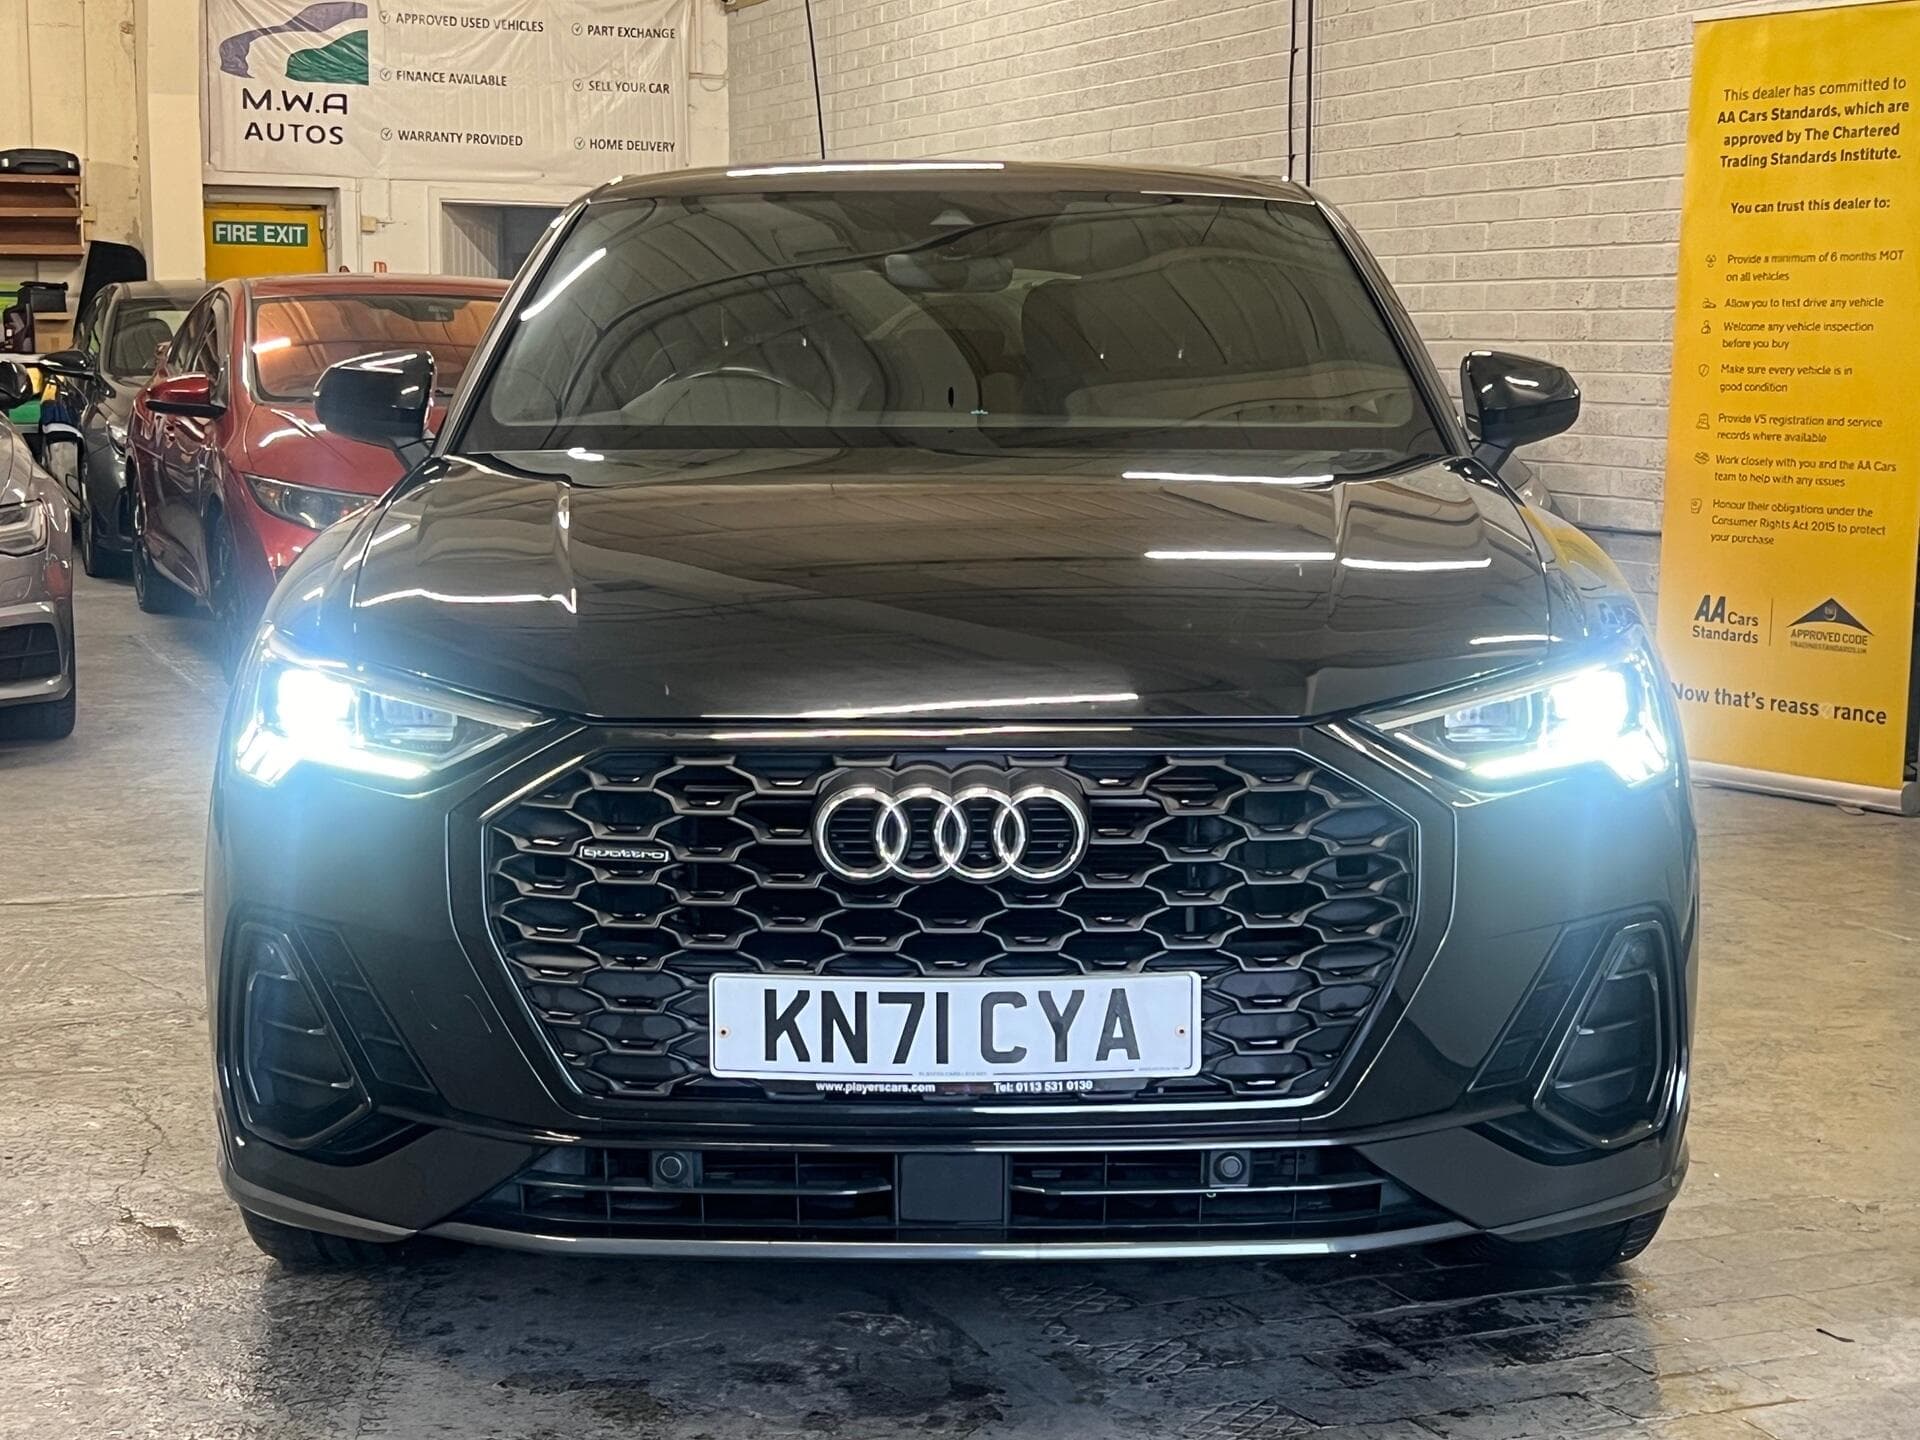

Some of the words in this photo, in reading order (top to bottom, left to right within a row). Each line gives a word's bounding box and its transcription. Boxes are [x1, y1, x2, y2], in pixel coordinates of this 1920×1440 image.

[396, 13, 457, 27] APPROVED
[461, 17, 490, 29] USED
[493, 19, 544, 32] VEHICLES
[587, 25, 614, 38] PART
[617, 26, 676, 39] EXCHANGE
[396, 70, 445, 84] FINANCE
[448, 73, 508, 87] AVAILABLE
[588, 80, 612, 92] SELL
[614, 81, 646, 94] YOUR
[648, 82, 670, 95] CAR
[1724, 88, 1748, 101] This
[1752, 85, 1791, 100] dealer
[1794, 84, 1815, 97] has
[1819, 77, 1889, 95] committed
[1893, 77, 1906, 89] to
[242, 88, 347, 115] M.W.A
[1717, 112, 1735, 125] AA
[1739, 110, 1768, 123] Cars
[1771, 105, 1841, 121] Standards,
[1844, 101, 1885, 116] which
[1887, 101, 1909, 113] are
[244, 122, 344, 145] AUTOS
[398, 129, 463, 144] WARRANTY
[466, 133, 523, 146] PROVIDED
[1723, 130, 1783, 147] approved
[1786, 129, 1802, 144] by
[1804, 128, 1829, 141] The
[1833, 123, 1900, 139] Chartered
[589, 138, 623, 151] HOME
[626, 139, 675, 152] DELIVERY
[1720, 155, 1768, 169] Trading
[1770, 150, 1837, 166] Standards
[1840, 147, 1901, 161] Institute.
[1731, 202, 1752, 214] You
[1754, 203, 1774, 213] can
[1777, 201, 1804, 212] trust
[1808, 199, 1830, 211] this
[1833, 198, 1871, 210] dealer
[1873, 197, 1890, 208] to:
[216, 224, 257, 242] FIRE
[263, 225, 305, 244] EXIT
[1727, 254, 1761, 264] Provide
[1771, 254, 1815, 263] minimum
[1818, 252, 1829, 262] of
[1830, 252, 1838, 262] 6
[1839, 252, 1876, 262] months
[1879, 250, 1904, 260] MOT
[1726, 273, 1738, 282] on
[1740, 272, 1750, 281] all
[1752, 272, 1790, 281] vehicles
[1724, 298, 1750, 308] Allow
[1751, 300, 1768, 309] you
[1770, 299, 1779, 308] to
[1803, 298, 1827, 307] drive
[1829, 299, 1846, 309] any
[1849, 297, 1884, 307] vehicle
[1723, 322, 1765, 331] Welcome
[1767, 323, 1783, 333] any
[1786, 321, 1821, 331] vehicle
[1823, 321, 1874, 333] inspection
[1722, 339, 1751, 348] before
[1753, 340, 1769, 350] you
[1772, 340, 1789, 350] buy
[1721, 364, 1745, 374] Make
[1747, 366, 1766, 375] sure
[1768, 367, 1794, 377] every
[1797, 365, 1831, 375] vehicle
[1834, 366, 1841, 375] is
[1844, 366, 1852, 375] in
[1720, 383, 1742, 393] good
[1744, 383, 1787, 392] condition
[1719, 414, 1751, 424] Provide
[1769, 415, 1824, 426] registration
[1827, 416, 1844, 426] and
[1847, 418, 1883, 428] service
[1717, 431, 1750, 440] records
[1752, 432, 1782, 441] where
[1784, 433, 1827, 443] available
[1716, 455, 1739, 465] Work
[1741, 456, 1772, 468] closely
[1775, 457, 1797, 468] with
[1799, 460, 1816, 470] you
[1819, 459, 1836, 469] and
[1839, 460, 1855, 470] the
[1857, 461, 1871, 471] AA
[1874, 461, 1896, 472] Cars
[1715, 473, 1736, 482] team
[1738, 473, 1748, 482] to
[1750, 473, 1770, 484] help
[1773, 474, 1793, 484] with
[1796, 476, 1813, 487] any
[1816, 477, 1845, 487] issues
[1713, 499, 1746, 510] Honour
[1747, 501, 1769, 511] their
[1771, 502, 1824, 515] obligations
[1827, 506, 1855, 516] under
[1857, 507, 1873, 517] the
[1712, 516, 1758, 527] Consumer
[1760, 518, 1790, 530] Rights
[1792, 520, 1808, 530] Act
[1811, 521, 1835, 532] 2015
[1837, 523, 1847, 533] to
[1849, 525, 1886, 536] protect
[1710, 533, 1729, 543] your
[1731, 534, 1774, 545] purchase
[1694, 595, 1726, 623] AA
[1727, 611, 1759, 627] Cars
[1692, 625, 1759, 644] Standards
[1791, 629, 1840, 643] APPROVED
[1842, 633, 1868, 646] CODE
[1671, 682, 1709, 703] Now
[1714, 688, 1765, 710] that's
[584, 849, 664, 859] quattro
[764, 988, 950, 1065] KN71
[980, 988, 1142, 1065] CYA
[816, 1081, 935, 1095] www.playerscars.com
[993, 1082, 1014, 1093] Tel:
[1016, 1082, 1042, 1093] 0113
[1045, 1081, 1063, 1092] 531
[1066, 1080, 1093, 1091] 0130
